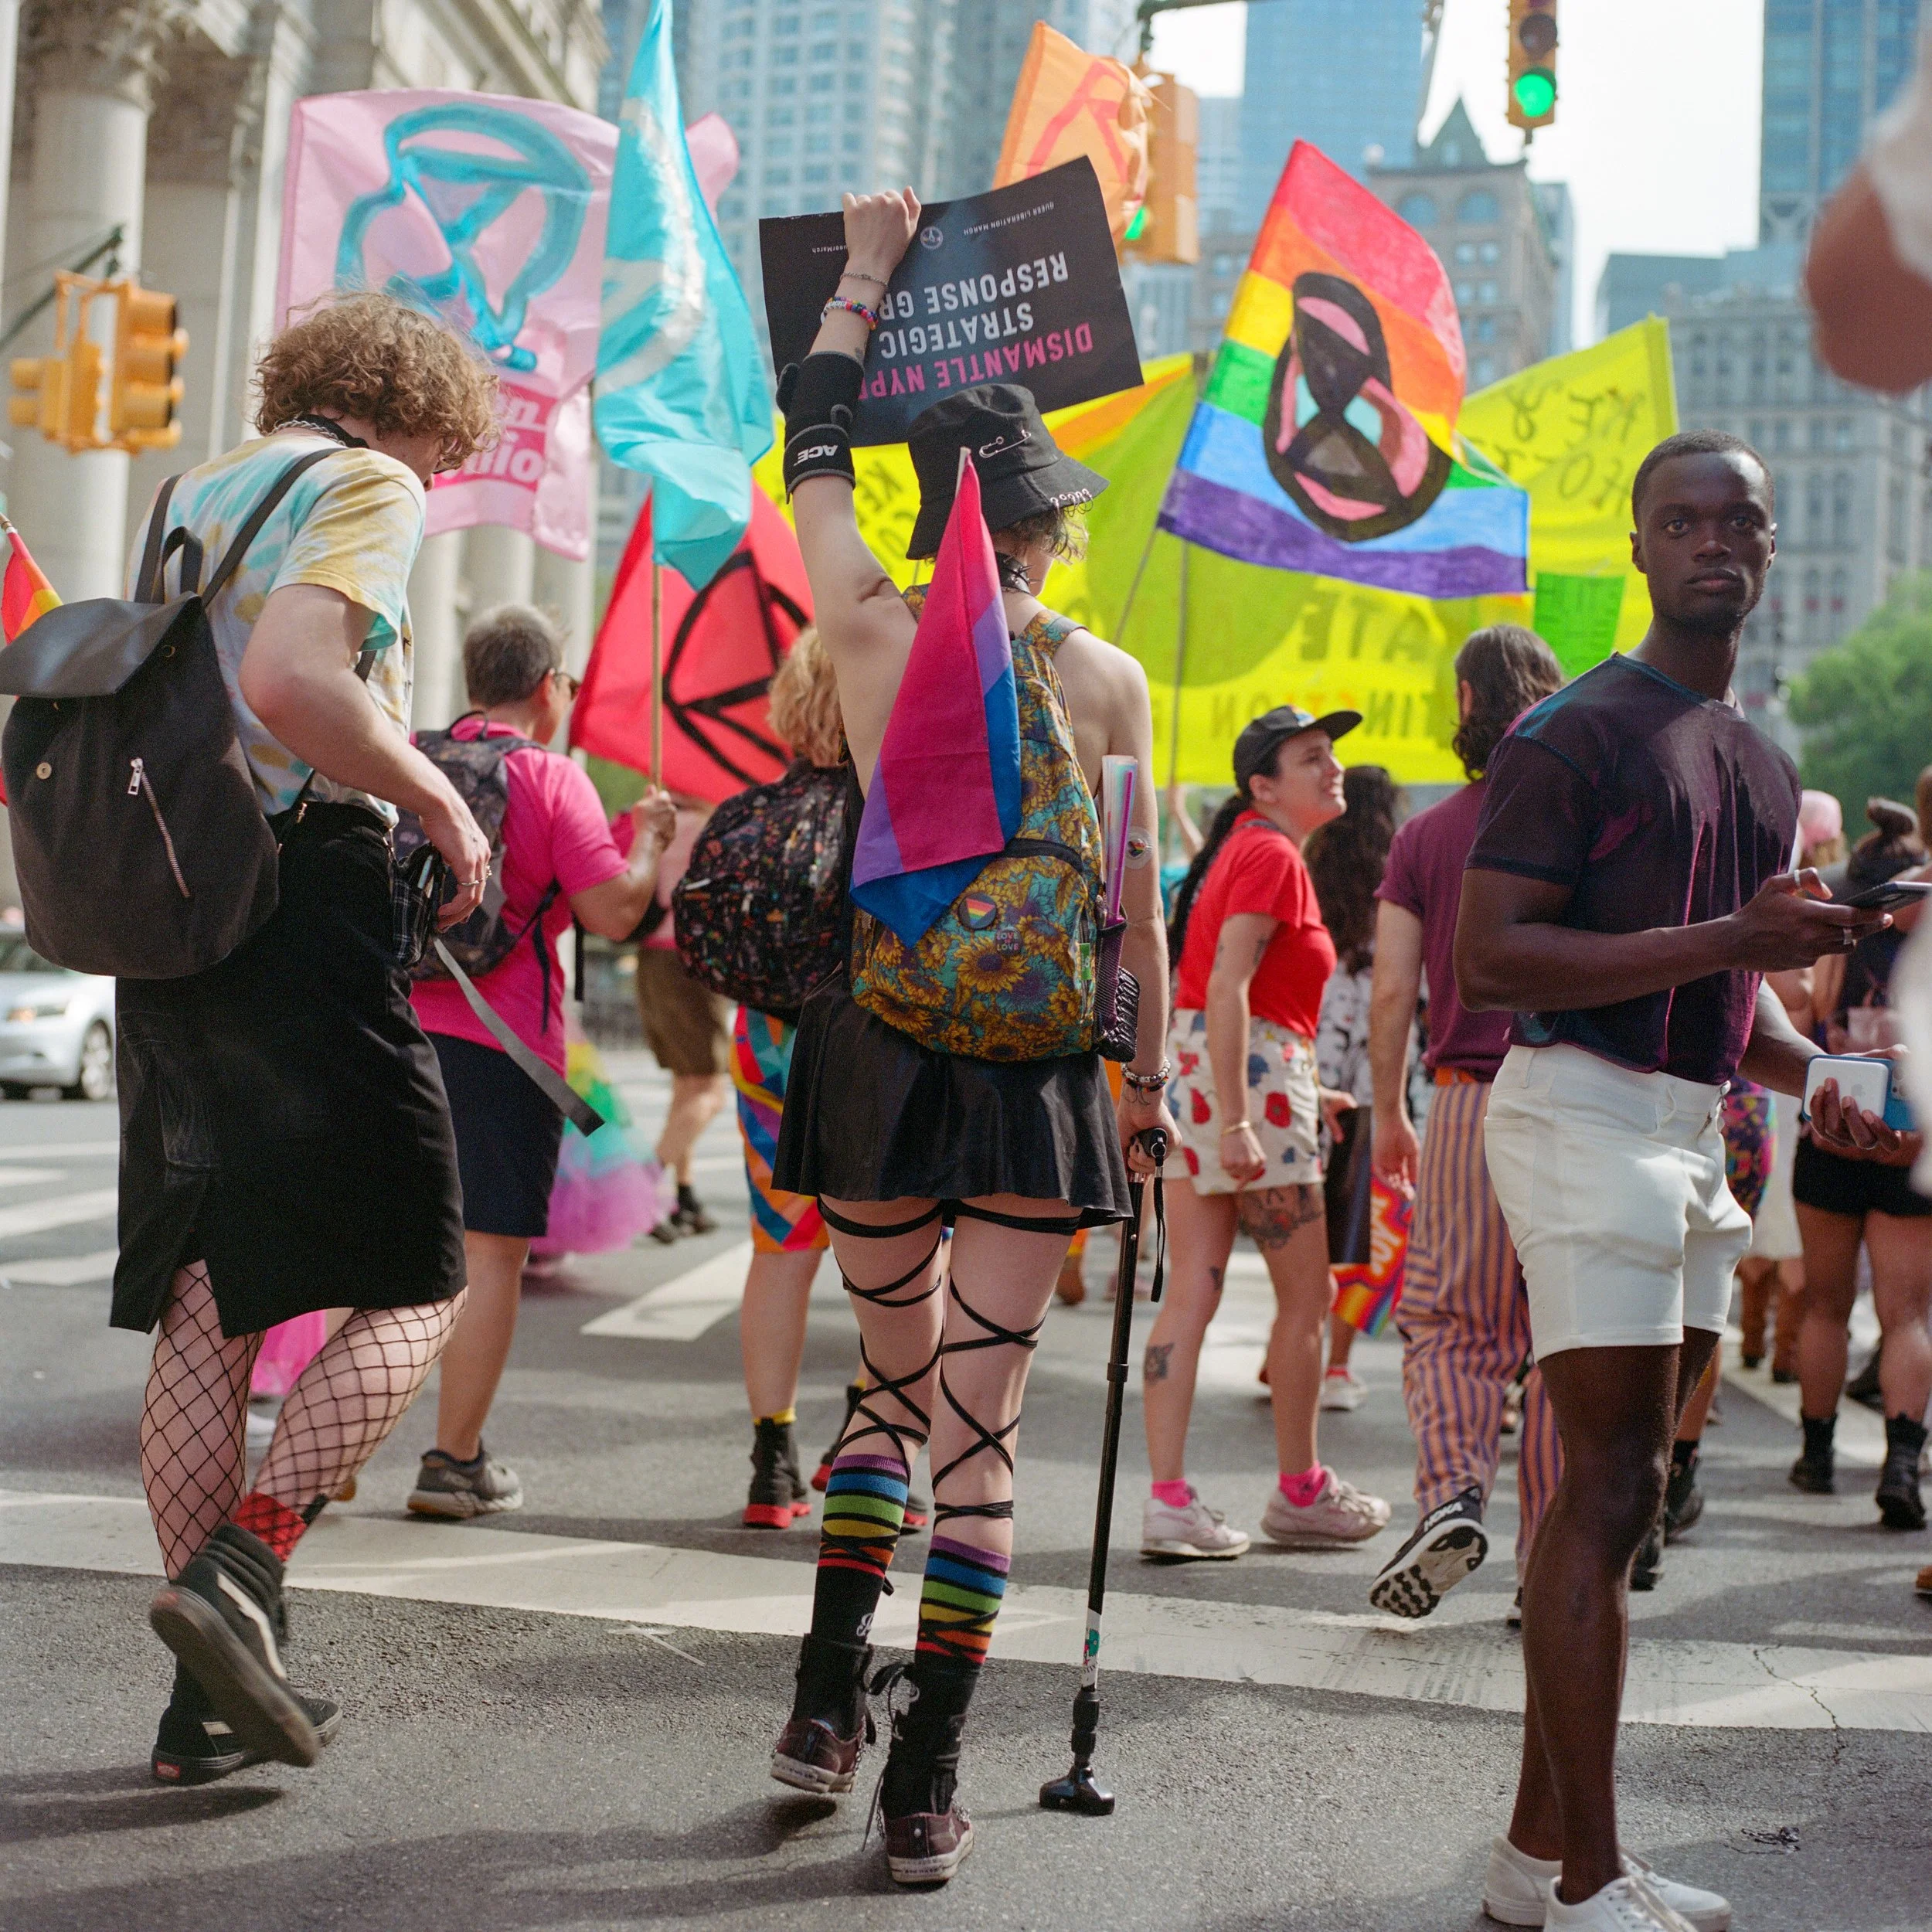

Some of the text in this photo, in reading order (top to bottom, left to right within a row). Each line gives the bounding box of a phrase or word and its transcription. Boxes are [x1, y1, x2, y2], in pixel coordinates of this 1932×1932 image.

[963, 201, 1055, 236] QUEER LIBERATION MARCH
[811, 244, 847, 254] ueerMarch
[879, 252, 1069, 321] RESPONSE GR
[879, 302, 1035, 359] STRATEGIC
[934, 322, 1094, 388] DISMANTLE
[793, 444, 838, 467] ACE
[997, 930, 1019, 940] LOVE
[997, 943, 1019, 951] LOVE
